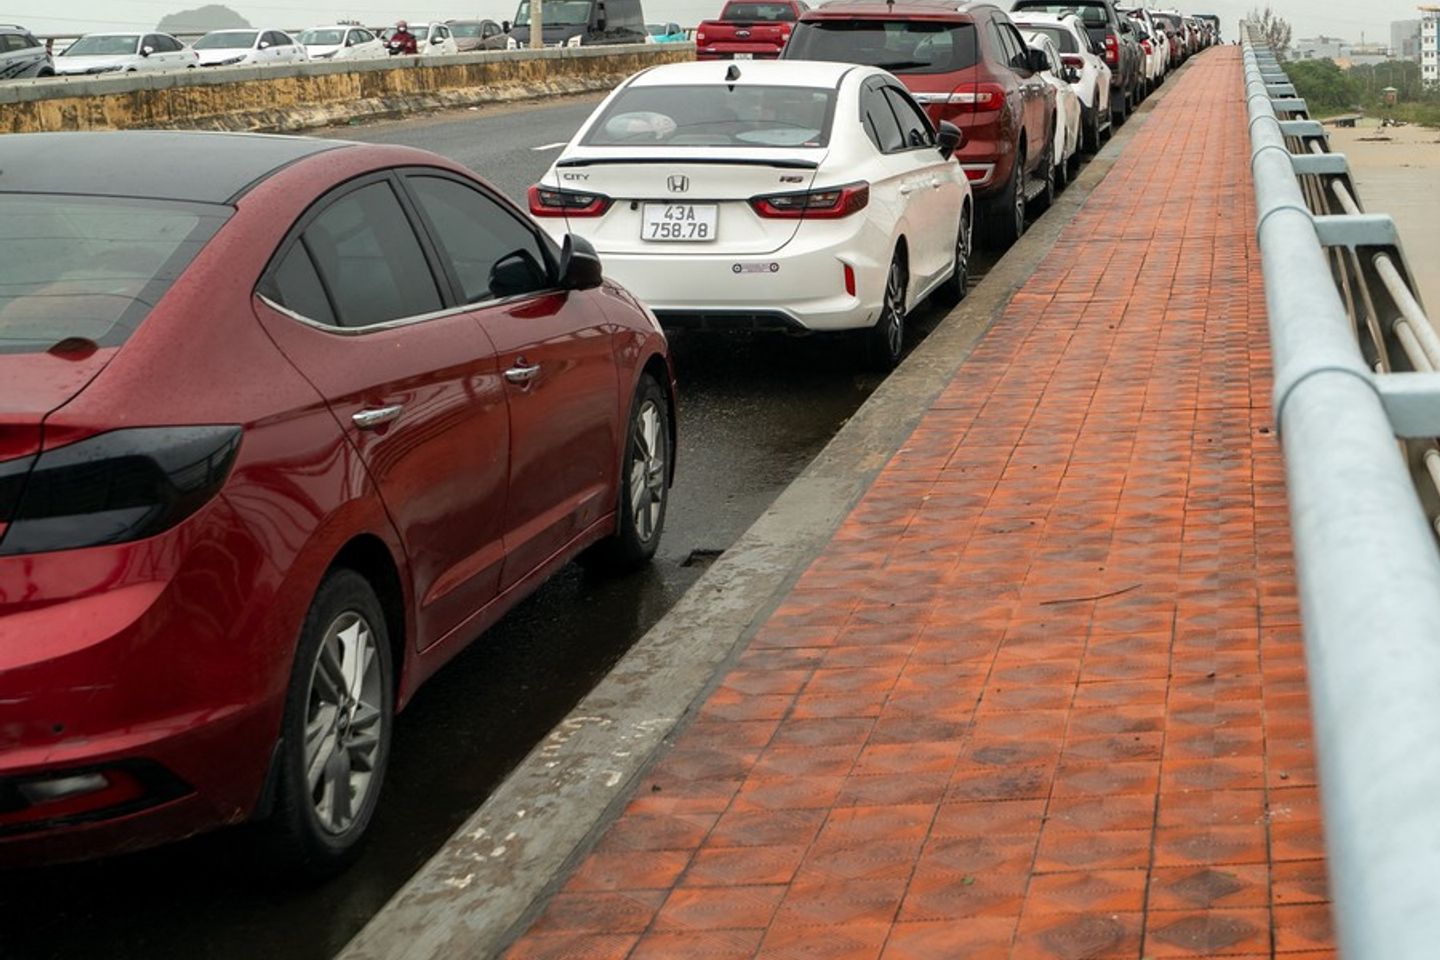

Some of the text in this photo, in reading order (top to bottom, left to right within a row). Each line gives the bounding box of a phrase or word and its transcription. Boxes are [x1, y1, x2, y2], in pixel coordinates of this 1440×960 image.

[563, 173, 590, 181] CITY
[664, 206, 695, 221] 43A
[650, 222, 708, 238] 758.78
